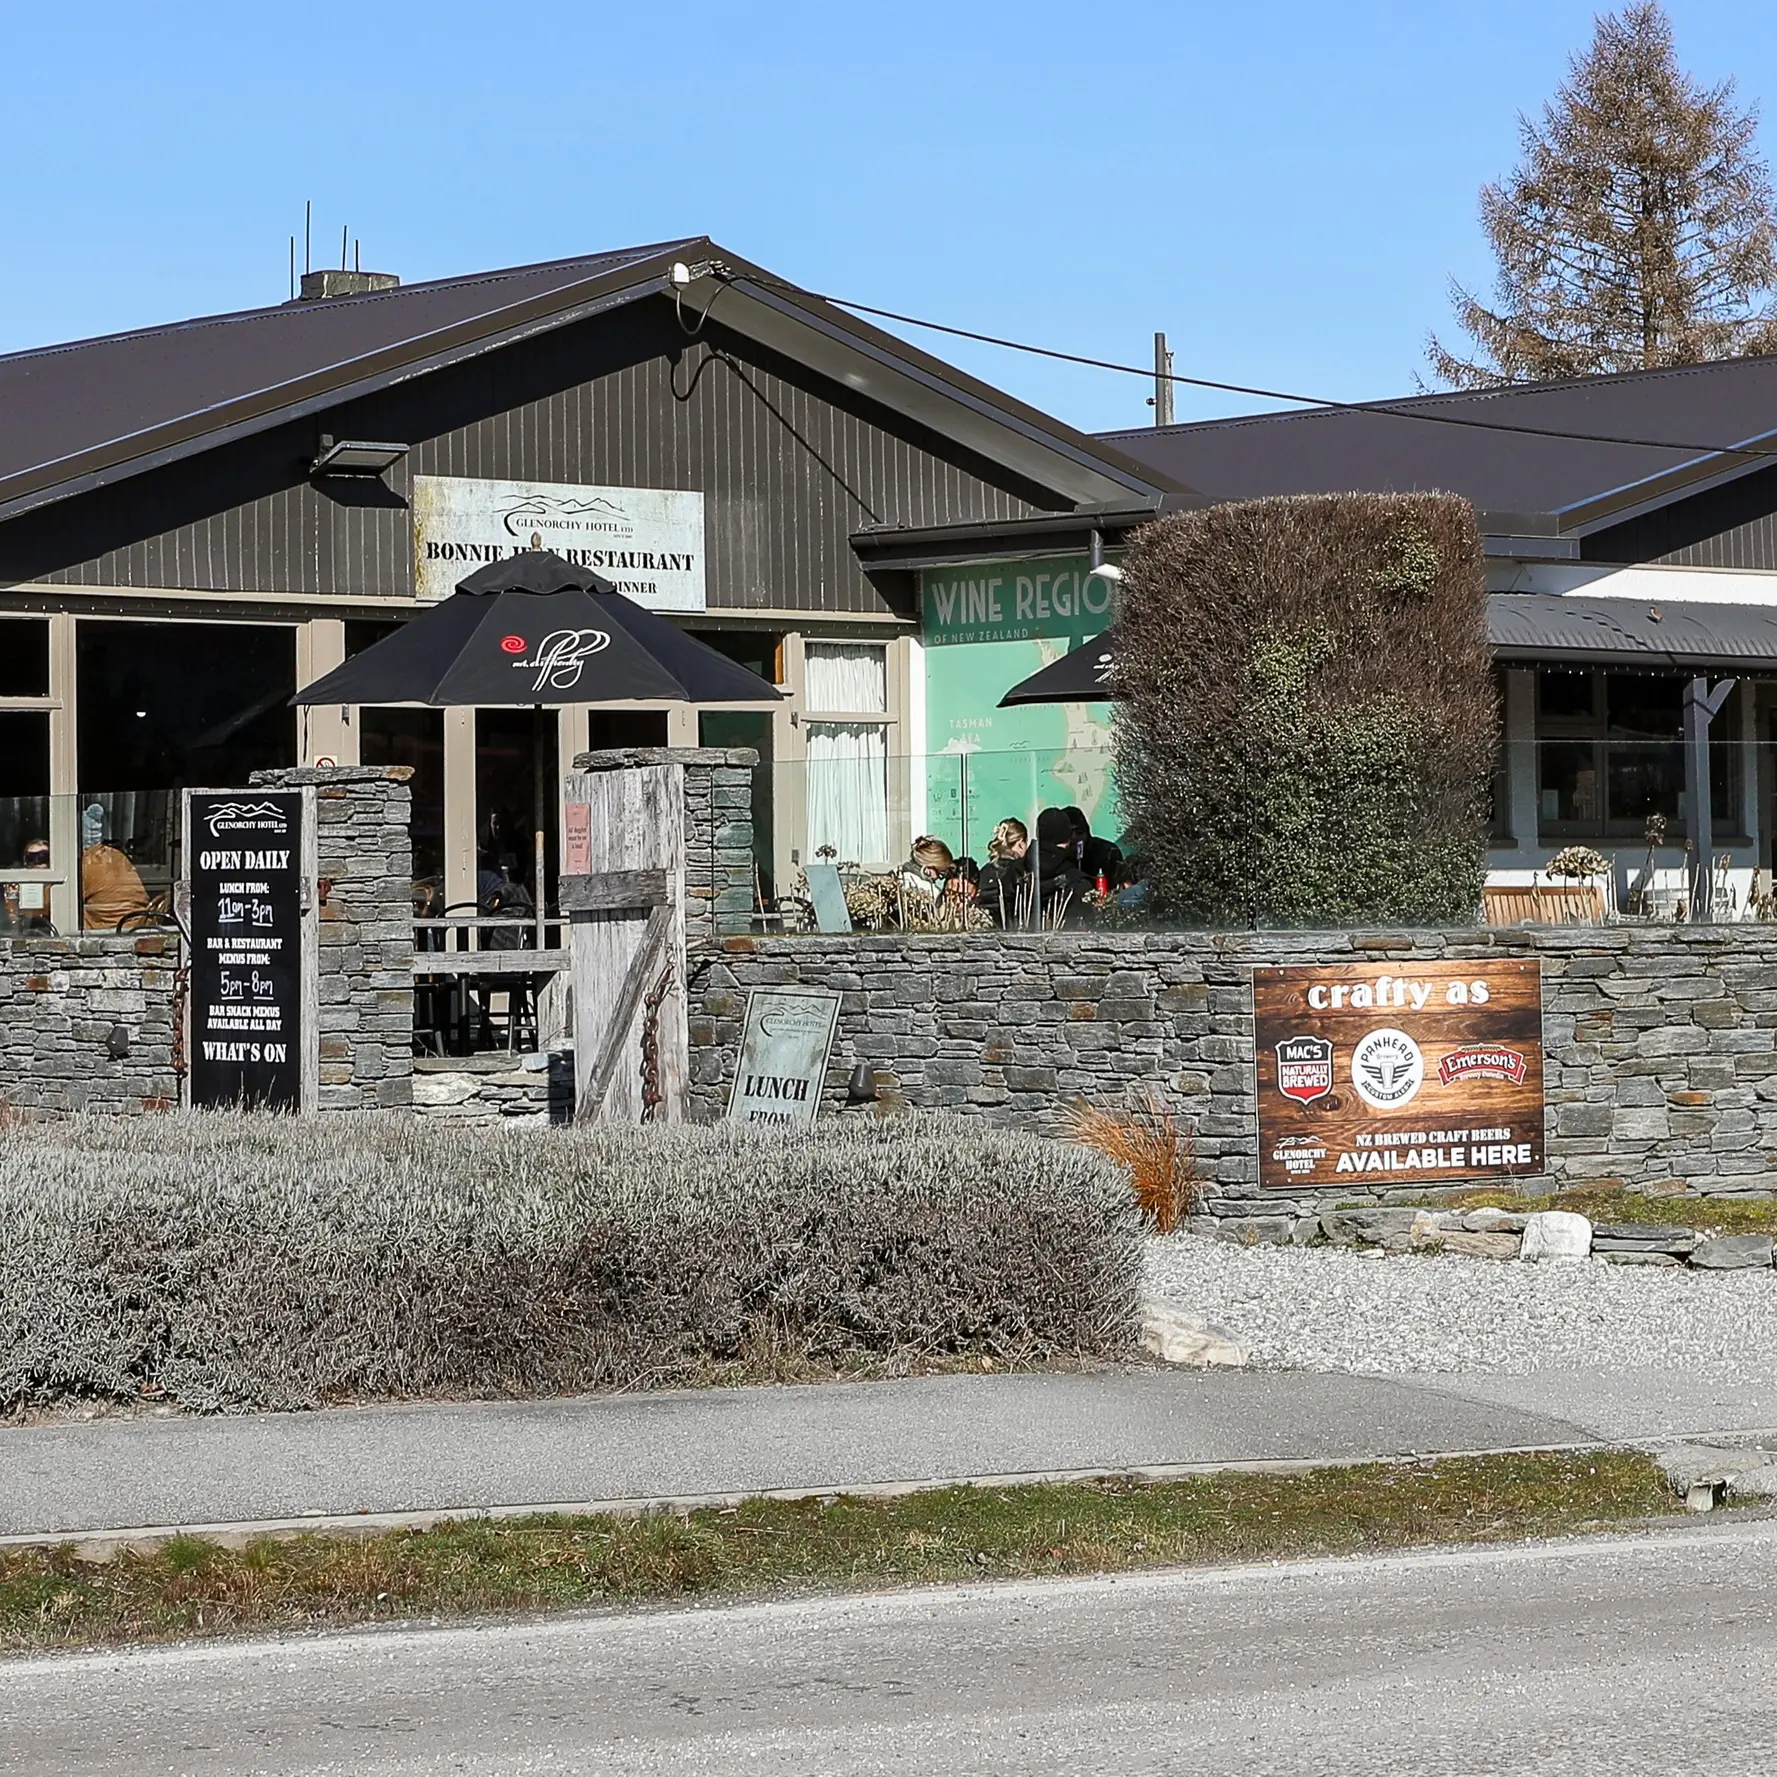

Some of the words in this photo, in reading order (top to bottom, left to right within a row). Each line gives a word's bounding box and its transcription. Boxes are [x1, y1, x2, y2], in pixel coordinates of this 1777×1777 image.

[516, 518, 581, 530] GLENORCHY
[586, 522, 619, 532] HOTEL
[426, 541, 503, 562] BONNIE
[566, 548, 695, 571] RESTAURANT
[931, 578, 1003, 626] WINE
[934, 633, 947, 644] OF
[952, 631, 975, 643] NEW
[979, 628, 1028, 642] ZEALAND
[949, 717, 992, 729] TASMAN
[960, 733, 981, 743] SEA
[217, 820, 256, 829] GLENORCHY
[257, 820, 278, 829] HOTEL
[200, 851, 242, 870] OPEN
[244, 850, 290, 870] DAILY
[220, 882, 245, 894] LUNCH
[246, 882, 270, 894] FROM:
[207, 938, 223, 949] BAR
[225, 938, 230, 949] &
[231, 938, 282, 949] RESTAURANT
[219, 953, 245, 965] MENUS
[247, 954, 271, 965] FROM:
[1307, 975, 1432, 1010] crafty
[1445, 980, 1490, 1004] as
[209, 1005, 225, 1016] BAR
[226, 1005, 251, 1017] SNACK
[253, 1006, 280, 1017] MENUS
[207, 1018, 249, 1030] AVAILABLE
[250, 1019, 264, 1030] ALL
[266, 1019, 282, 1031] DAY
[202, 1041, 260, 1062] WHAT'S
[264, 1044, 287, 1063] ON
[1286, 1045, 1322, 1060] MAC'S
[1361, 1037, 1414, 1062] PANHEAD
[1282, 1064, 1328, 1076] NATURALLY
[1446, 1053, 1517, 1073] Emerson's
[744, 1075, 810, 1101] LUNCH
[1282, 1074, 1328, 1088] BREWED
[1356, 1134, 1372, 1147] NZ
[1374, 1131, 1427, 1146] BREWED
[1428, 1130, 1469, 1144] CRAFT
[1471, 1128, 1511, 1142] BEERS
[1272, 1148, 1327, 1160] GLENORCHY
[1335, 1147, 1465, 1173] AVAILABLE
[1470, 1144, 1532, 1166] HERE
[1285, 1159, 1316, 1170] HOTEL
